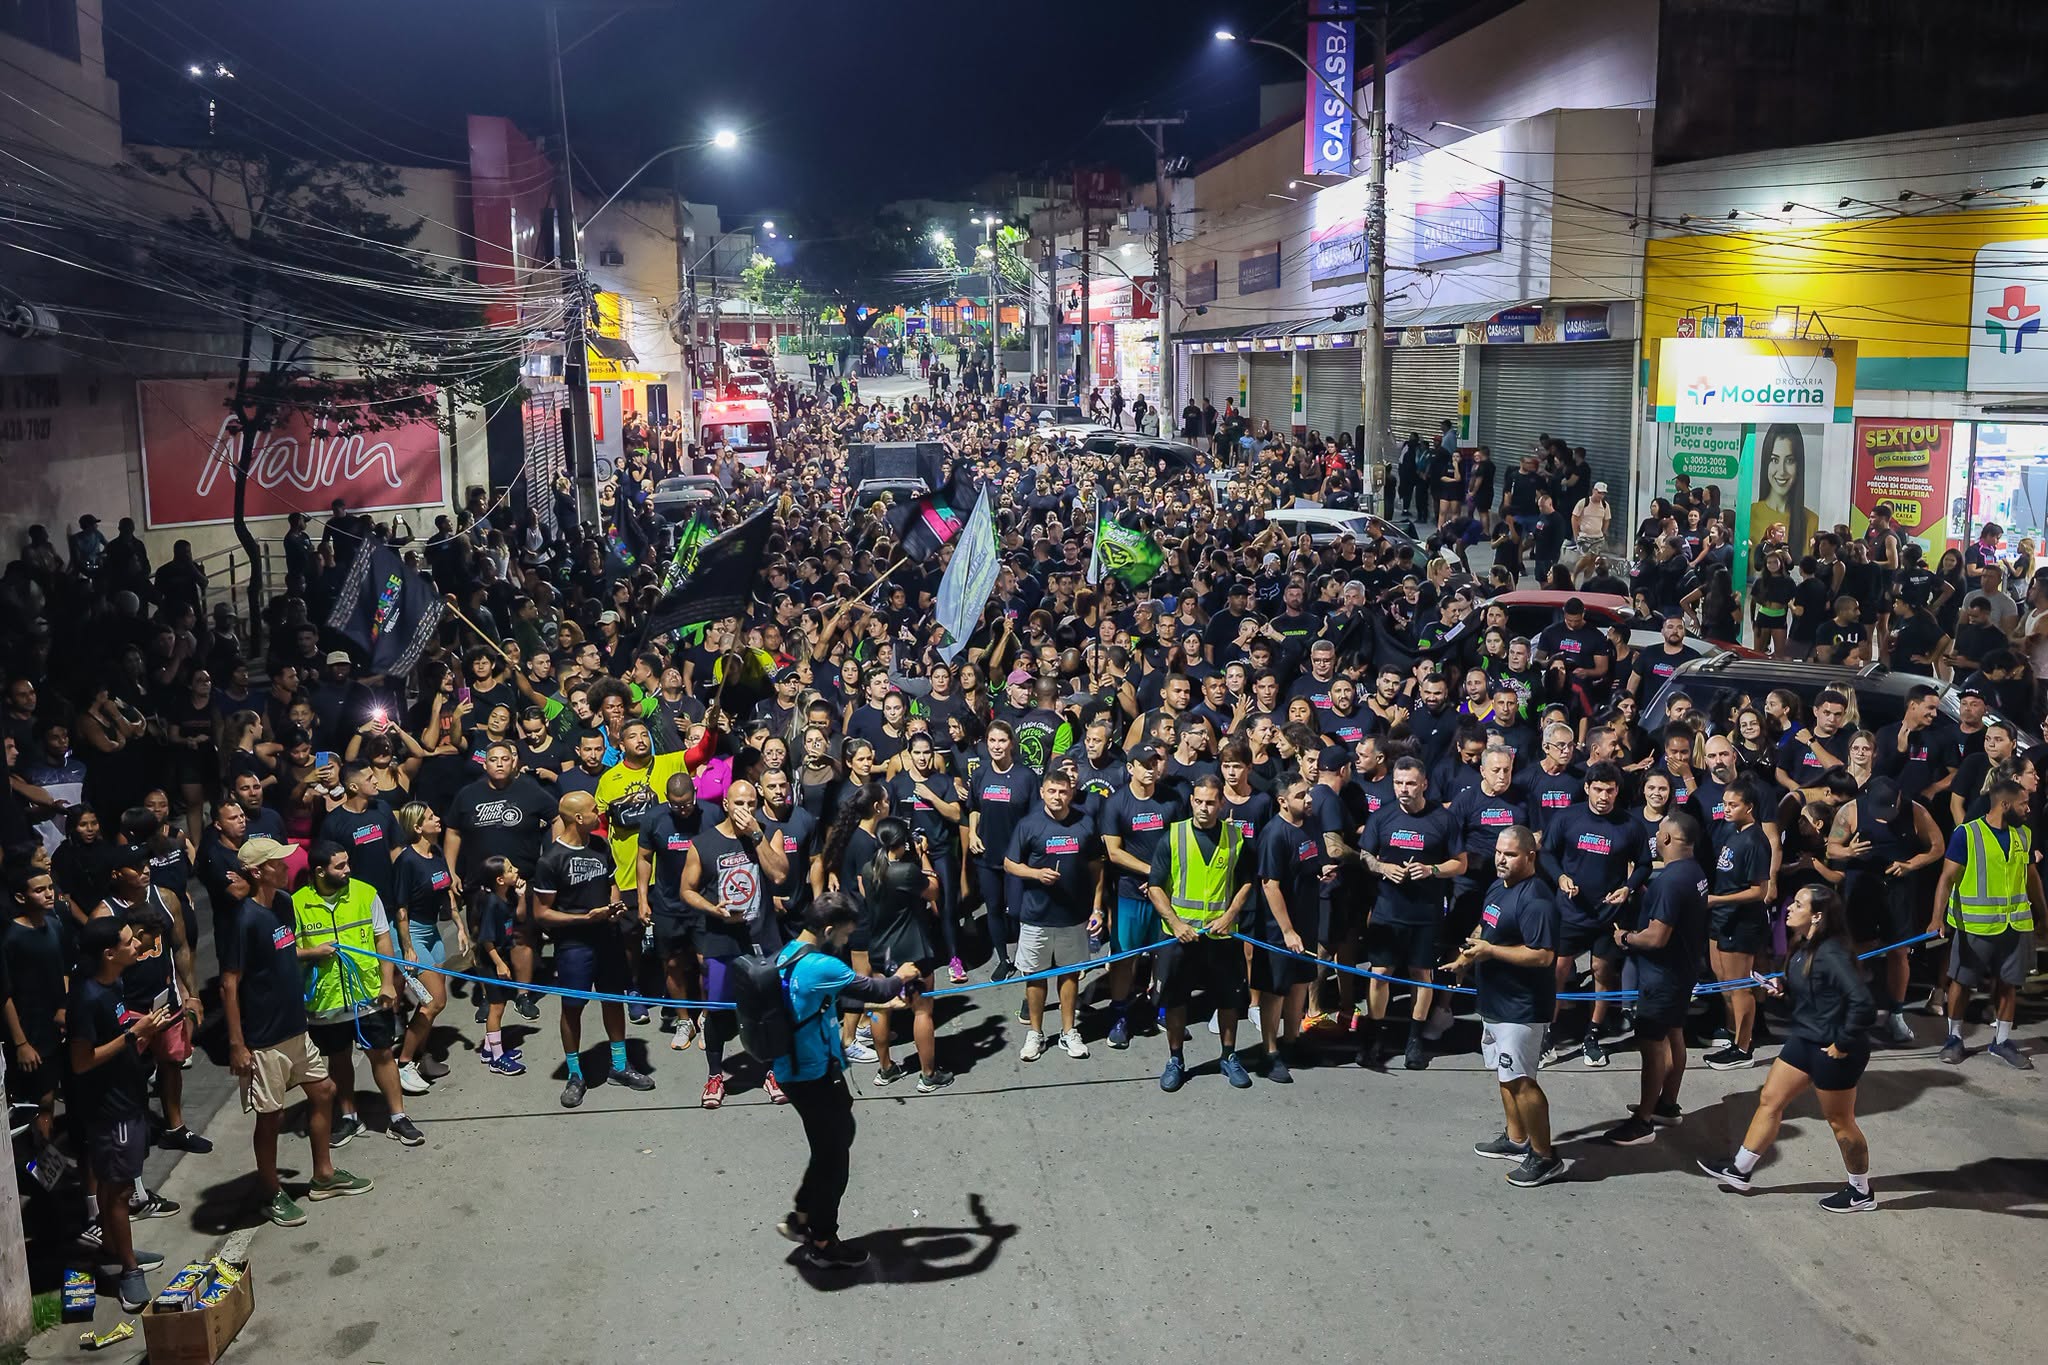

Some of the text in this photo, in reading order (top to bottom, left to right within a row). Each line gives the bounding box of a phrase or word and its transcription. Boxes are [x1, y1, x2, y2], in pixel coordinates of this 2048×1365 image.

[1775, 378, 1824, 386] DROGARIA
[1721, 384, 1825, 404] Moderna
[1674, 422, 1713, 437] Ligue e
[1865, 424, 1939, 449] SEXTOU
[1674, 435, 1740, 452] Peça agora!
[1690, 456, 1727, 466] 3003-2002
[1867, 481, 1889, 489] PREÇOS
[1900, 477, 1928, 485] MELHORES
[1889, 489, 1930, 498] SEXTA-FEIRA
